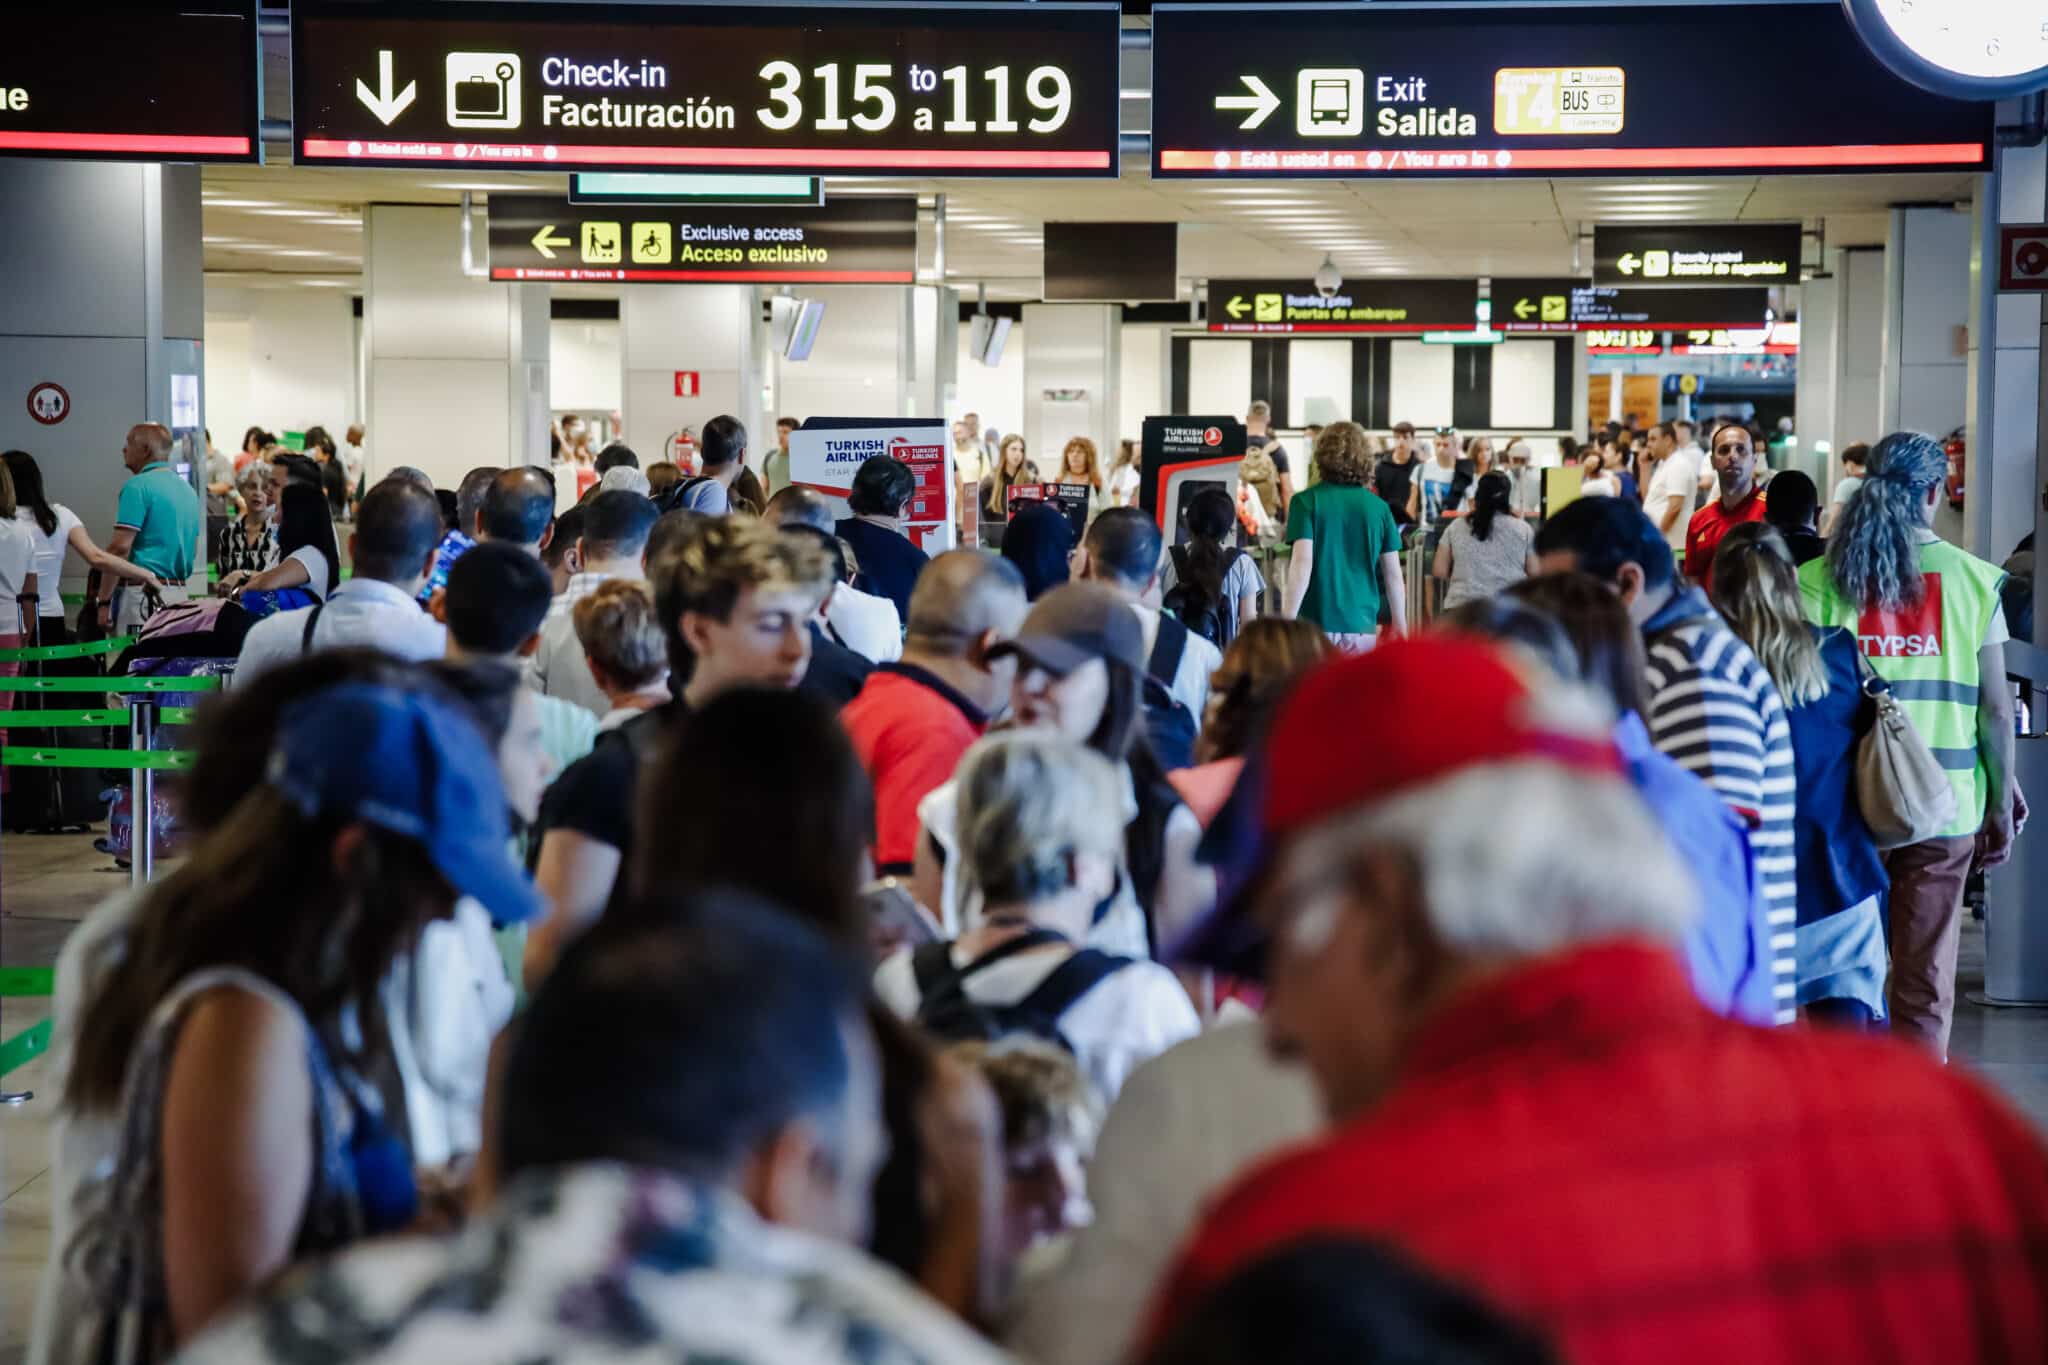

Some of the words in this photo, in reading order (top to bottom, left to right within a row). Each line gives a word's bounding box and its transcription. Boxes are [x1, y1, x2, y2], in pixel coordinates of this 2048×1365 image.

[542, 58, 666, 88] Check-in
[756, 60, 897, 131] 315
[909, 64, 936, 91] to
[942, 65, 1072, 133] 119
[1376, 76, 1427, 101] Exit
[1562, 91, 1589, 111] BUS
[542, 94, 735, 130] Facturación
[913, 105, 932, 131] a
[1377, 107, 1477, 137] Salida
[1240, 151, 1277, 166] Está
[1282, 151, 1328, 166] usted
[1334, 154, 1355, 166] en
[1403, 151, 1433, 166] You
[1438, 154, 1467, 166] are
[1471, 151, 1488, 166] in
[681, 223, 749, 240] Exclusive
[754, 227, 803, 241] access
[681, 245, 744, 263] Acceso
[748, 244, 828, 263] exclusivo
[1163, 435, 1204, 444] AIRLINES
[1164, 428, 1204, 436] TURKISH
[825, 440, 884, 451] TURKISH
[1858, 634, 1941, 656] TYPSA
